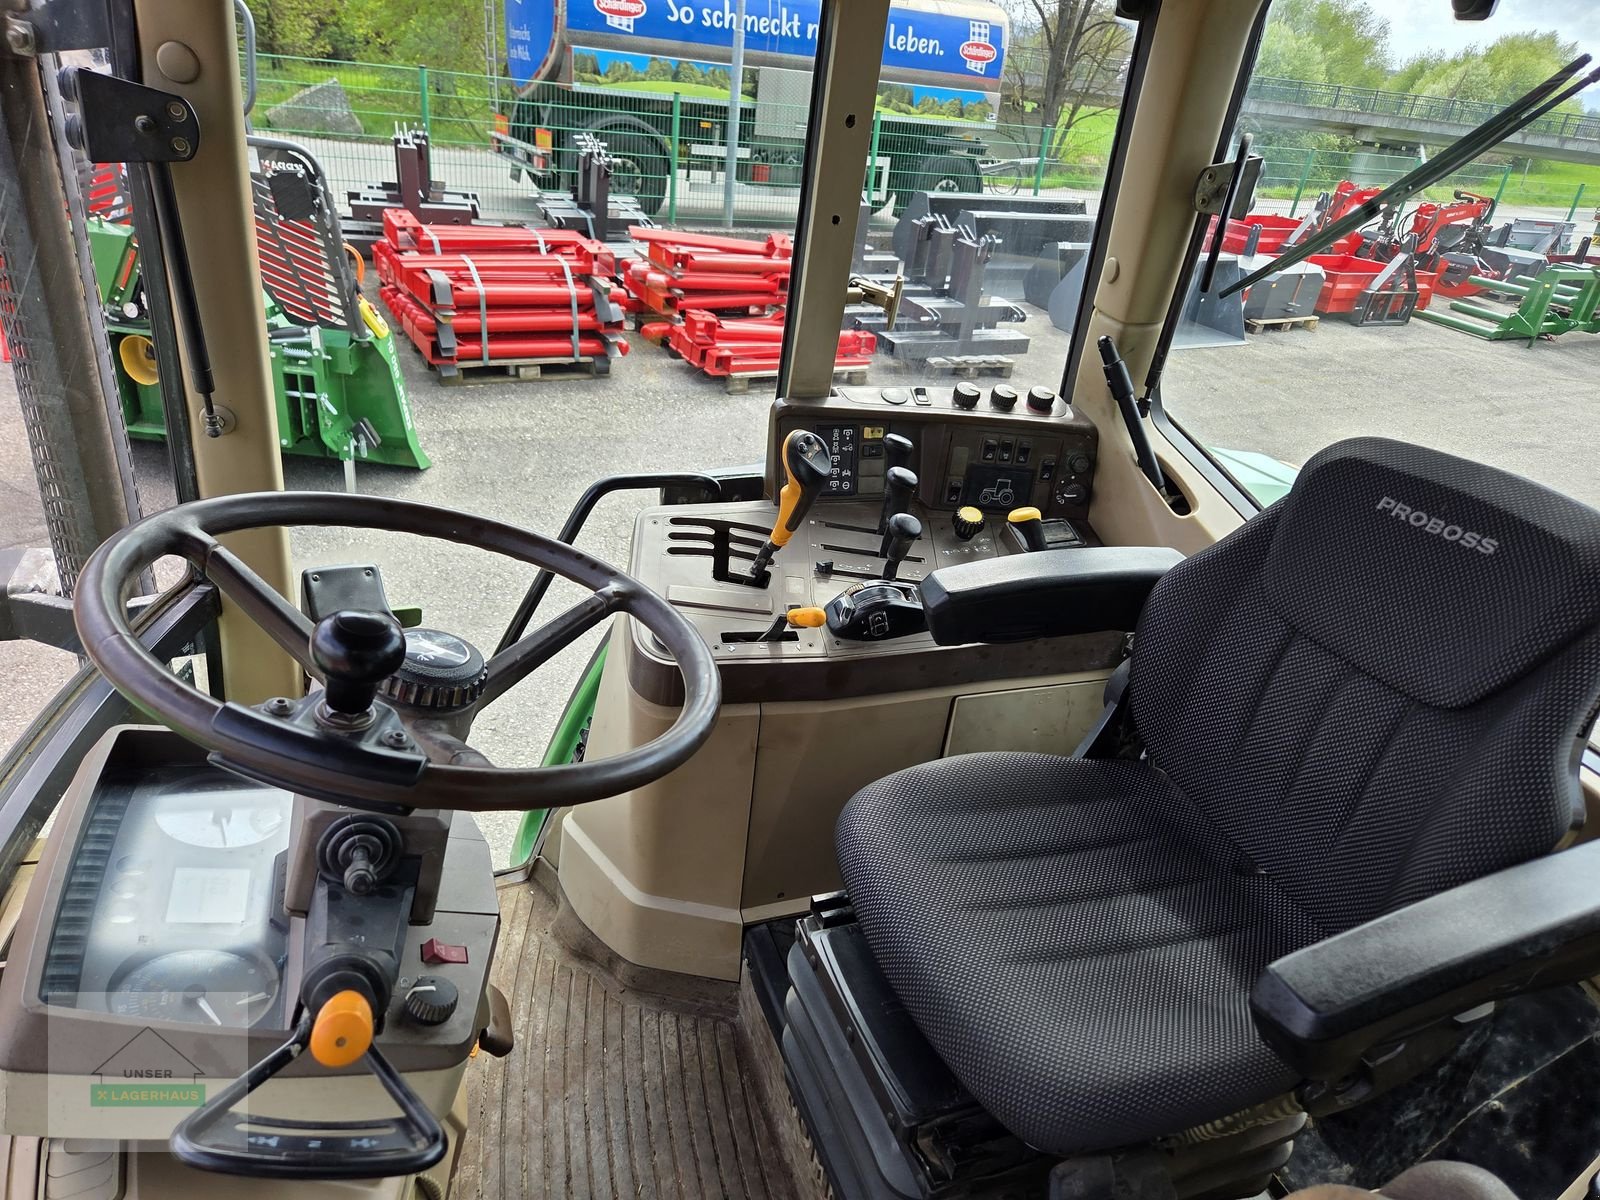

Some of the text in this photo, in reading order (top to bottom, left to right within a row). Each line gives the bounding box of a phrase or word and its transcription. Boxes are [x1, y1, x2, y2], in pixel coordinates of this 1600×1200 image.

[667, 0, 694, 24] So
[701, 0, 800, 38] schmeckt
[1376, 496, 1499, 554] PROBOSS
